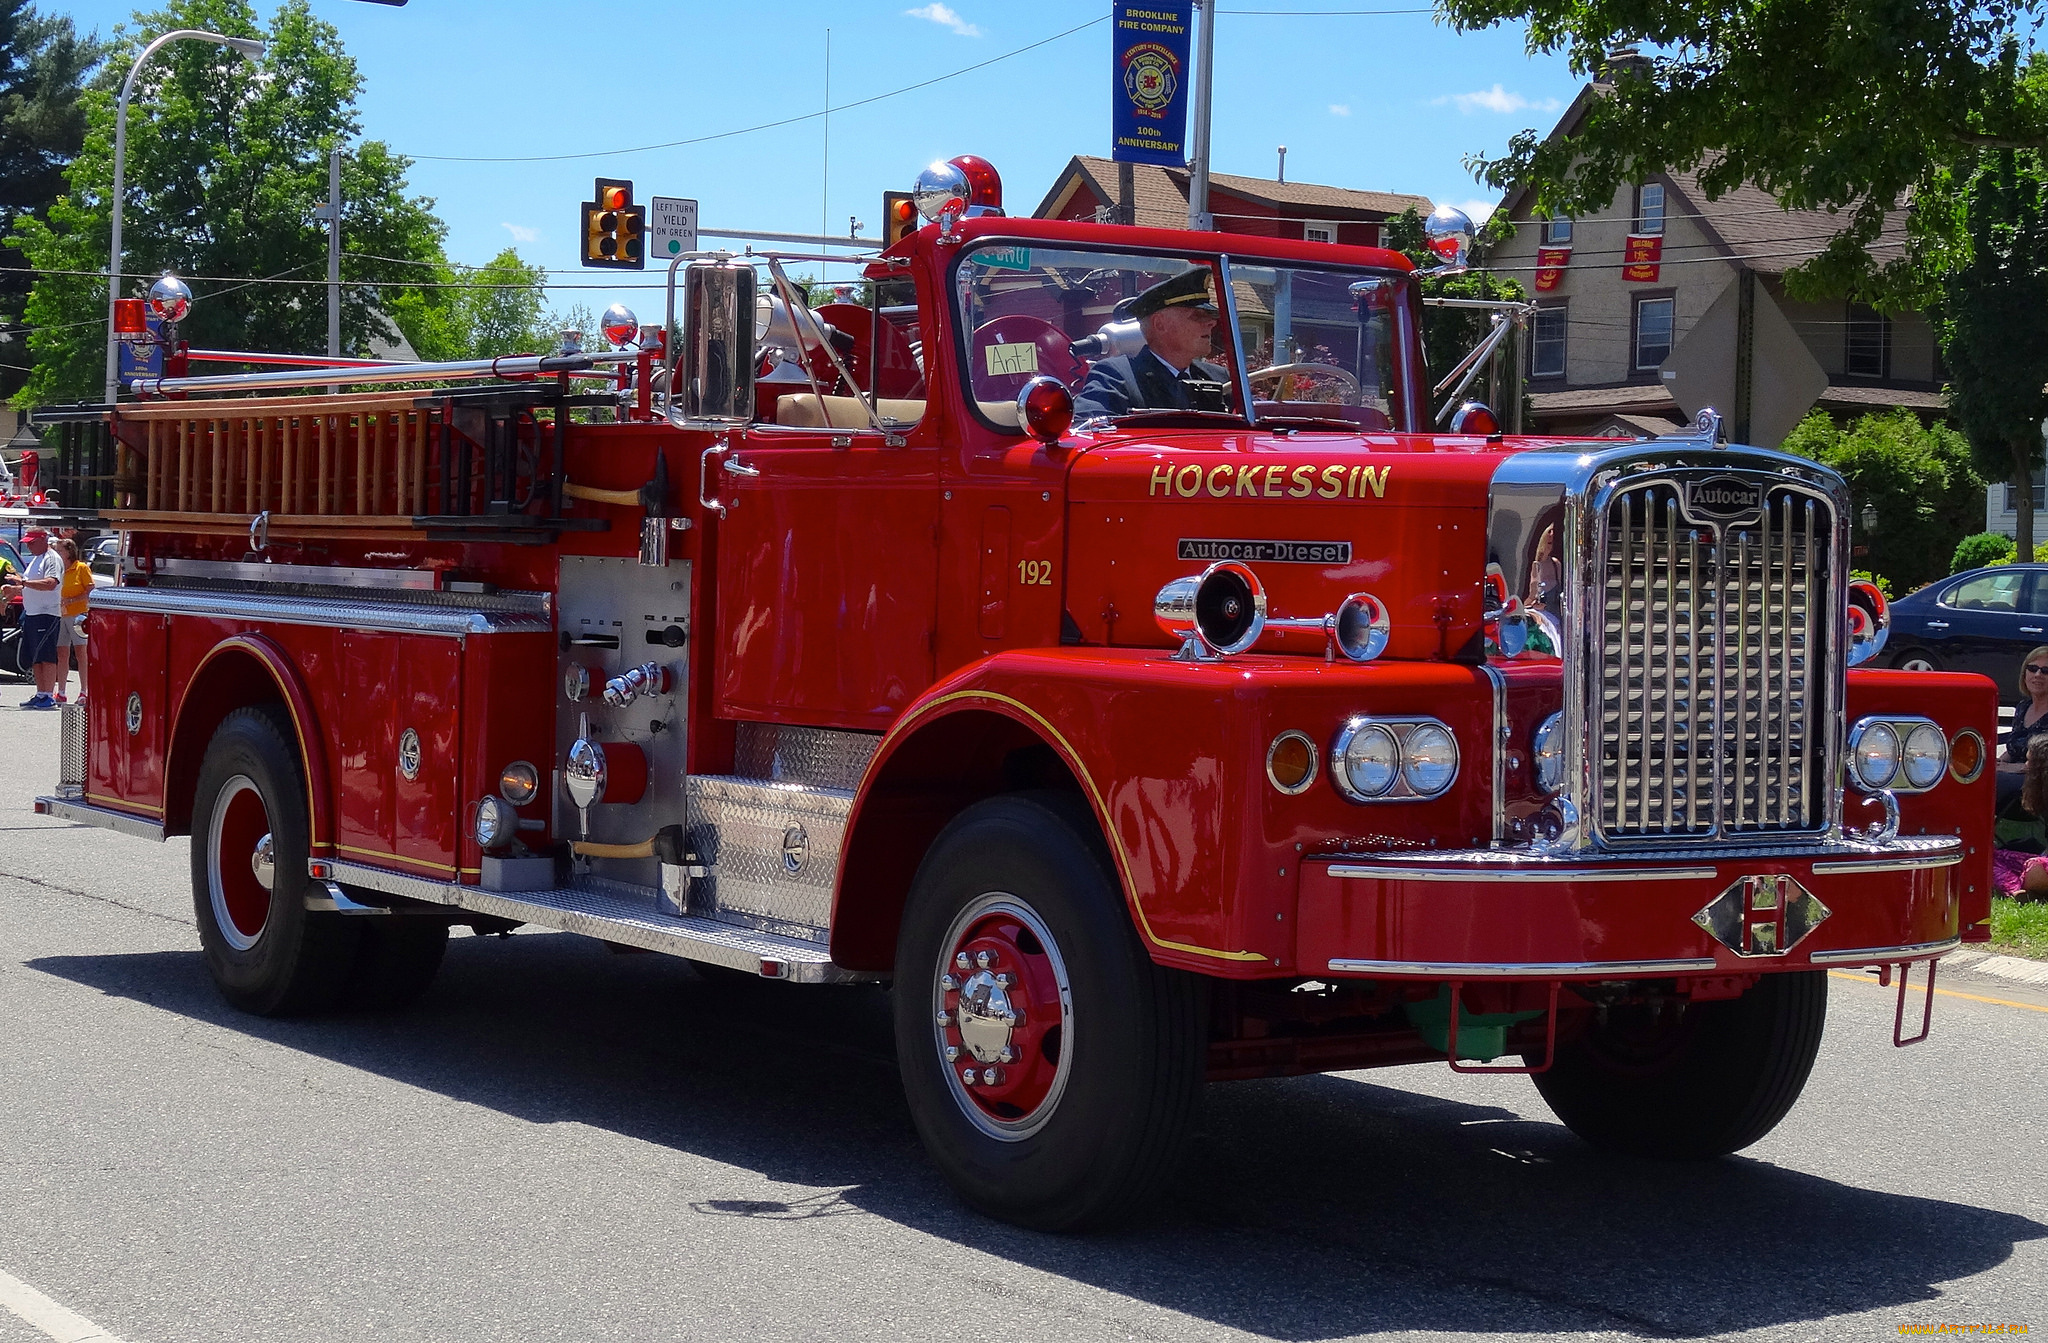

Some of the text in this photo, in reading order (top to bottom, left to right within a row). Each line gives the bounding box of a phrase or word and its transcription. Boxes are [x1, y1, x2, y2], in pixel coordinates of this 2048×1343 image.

[1126, 8, 1178, 22] BROOKLINE
[1119, 20, 1185, 35] FIRE COMPANY
[1127, 44, 1147, 57] CENTURY
[1152, 44, 1178, 65] EXCELLENCE
[1144, 75, 1157, 90] 35
[1137, 126, 1161, 137] 100th
[1118, 136, 1179, 152] ANNIVERSARY
[656, 202, 694, 214] LEFT TURN
[662, 214, 687, 226] YIELD
[656, 227, 693, 238] ON GREEN
[992, 345, 1038, 375] Ant-1
[1149, 463, 1393, 500] HOCKESSIN
[1692, 485, 1758, 506] Autocar
[1182, 541, 1345, 563] Autocar-Diesel
[1017, 559, 1053, 586] 192
[1742, 879, 1788, 953] H
